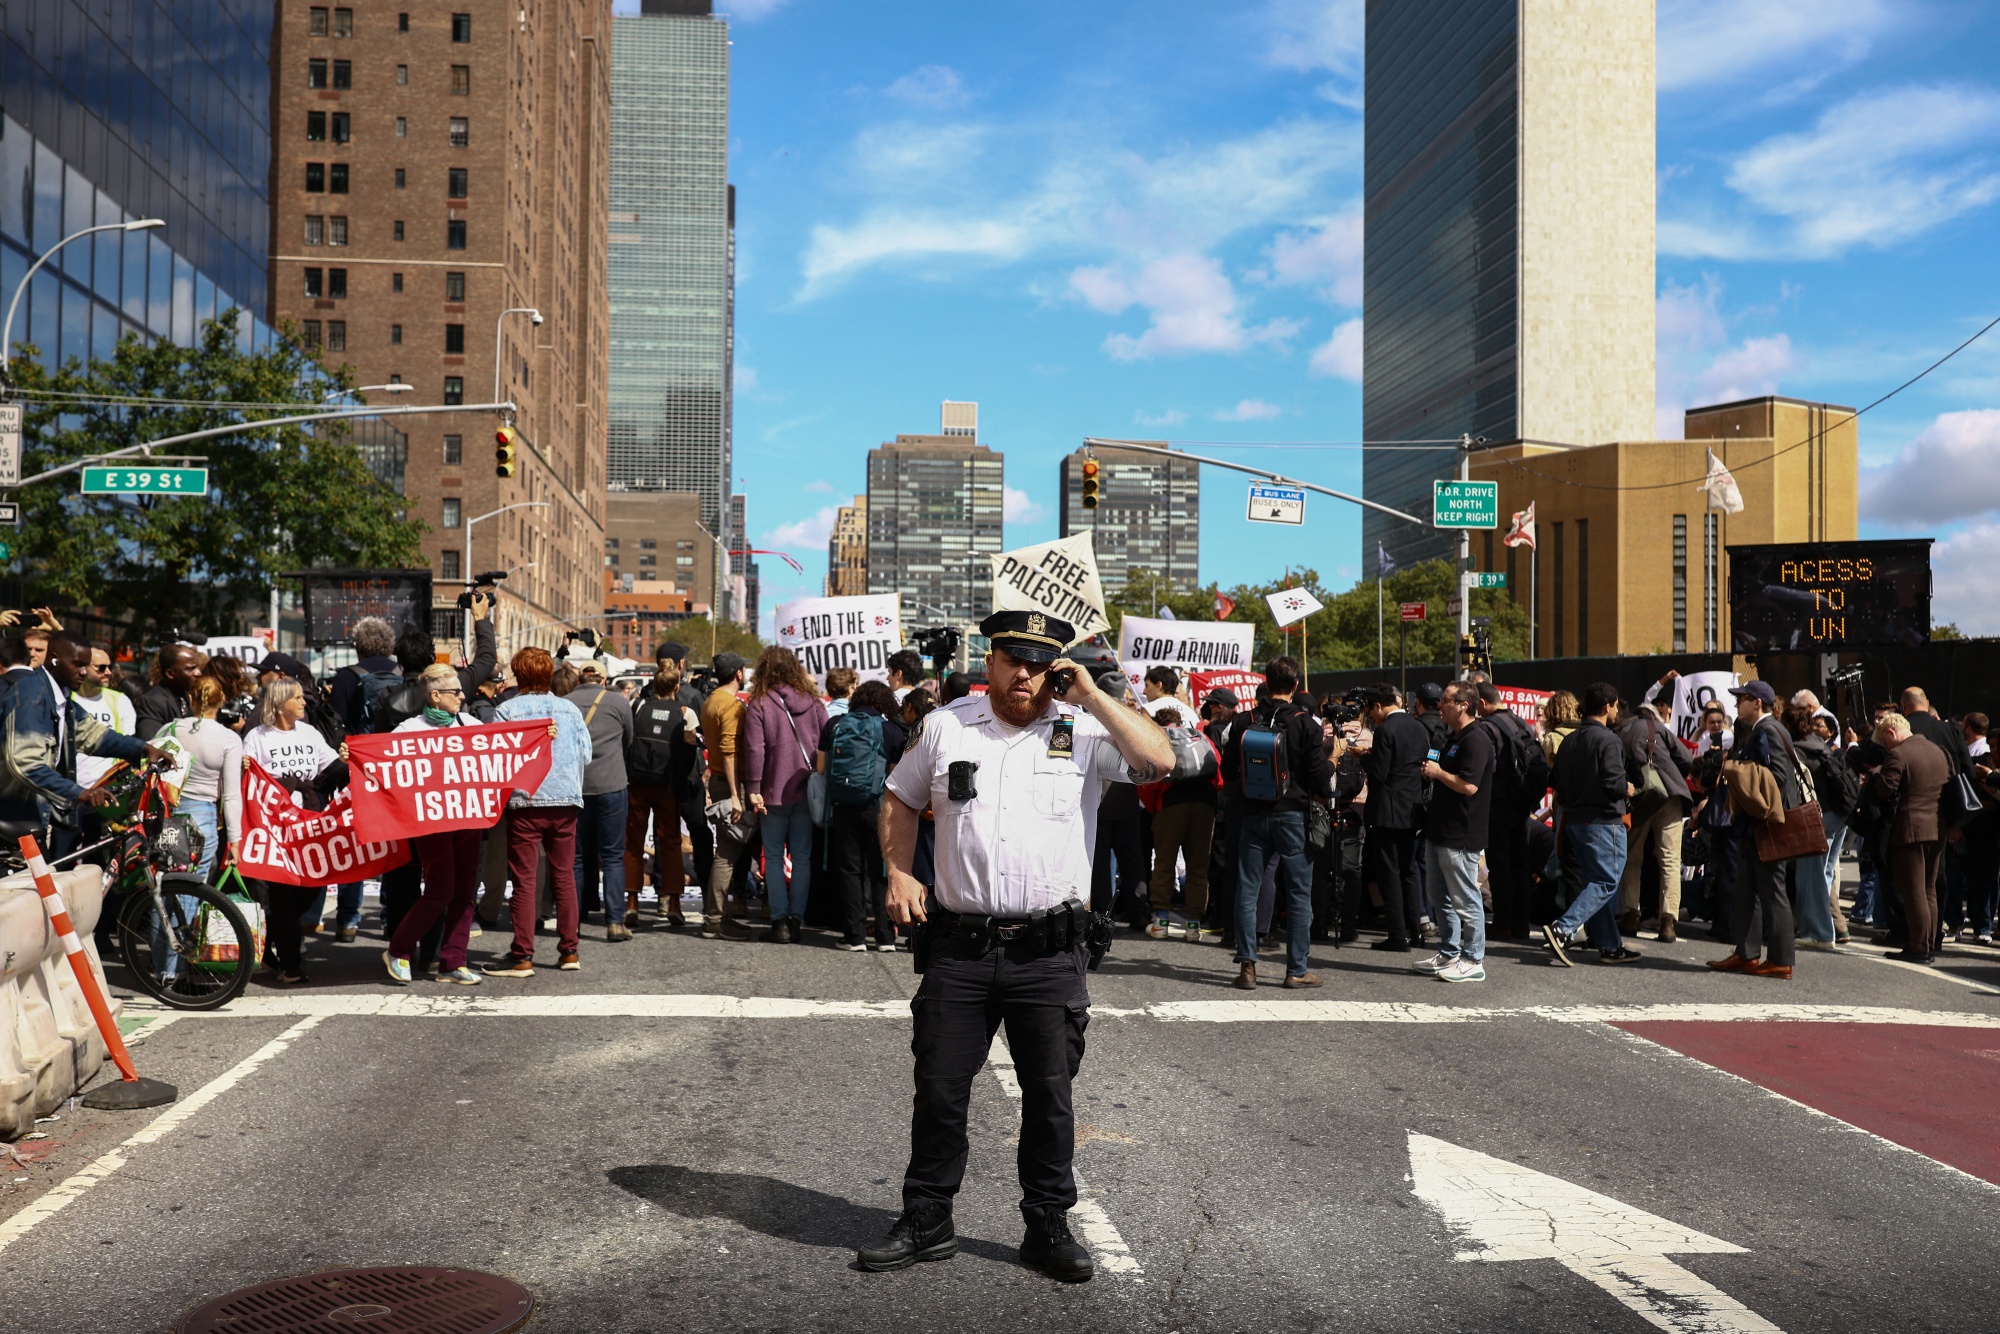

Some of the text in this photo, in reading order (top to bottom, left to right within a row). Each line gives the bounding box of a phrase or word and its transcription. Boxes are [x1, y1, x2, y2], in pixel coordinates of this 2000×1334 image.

[0, 411, 15, 421] RU
[0, 424, 17, 434] ING
[105, 473, 182, 489] E 39 St
[1465, 487, 1494, 497] DRIVE
[1252, 498, 1300, 509] BUSES ONLY
[1449, 499, 1483, 509] NORTH
[1437, 511, 1495, 522] KEEP RIGHT
[1040, 549, 1090, 592] FREE
[1781, 558, 1872, 583] ACESS
[341, 580, 389, 597] MUST
[1479, 575, 1484, 587] E
[1486, 574, 1497, 587] 39
[997, 556, 1101, 632] PALESTINE
[1809, 588, 1845, 611] TO
[344, 600, 391, 618] TURN
[801, 611, 865, 640] END THE
[1810, 617, 1845, 640] UN
[794, 639, 893, 675] ENOCIDE
[1131, 637, 1240, 665] STOP ARMING
[1206, 674, 1243, 687] JEWS
[269, 744, 314, 759] FUND
[383, 732, 524, 757] JEWS SAY
[363, 758, 432, 793] STOP
[415, 788, 501, 821] ISRAE
